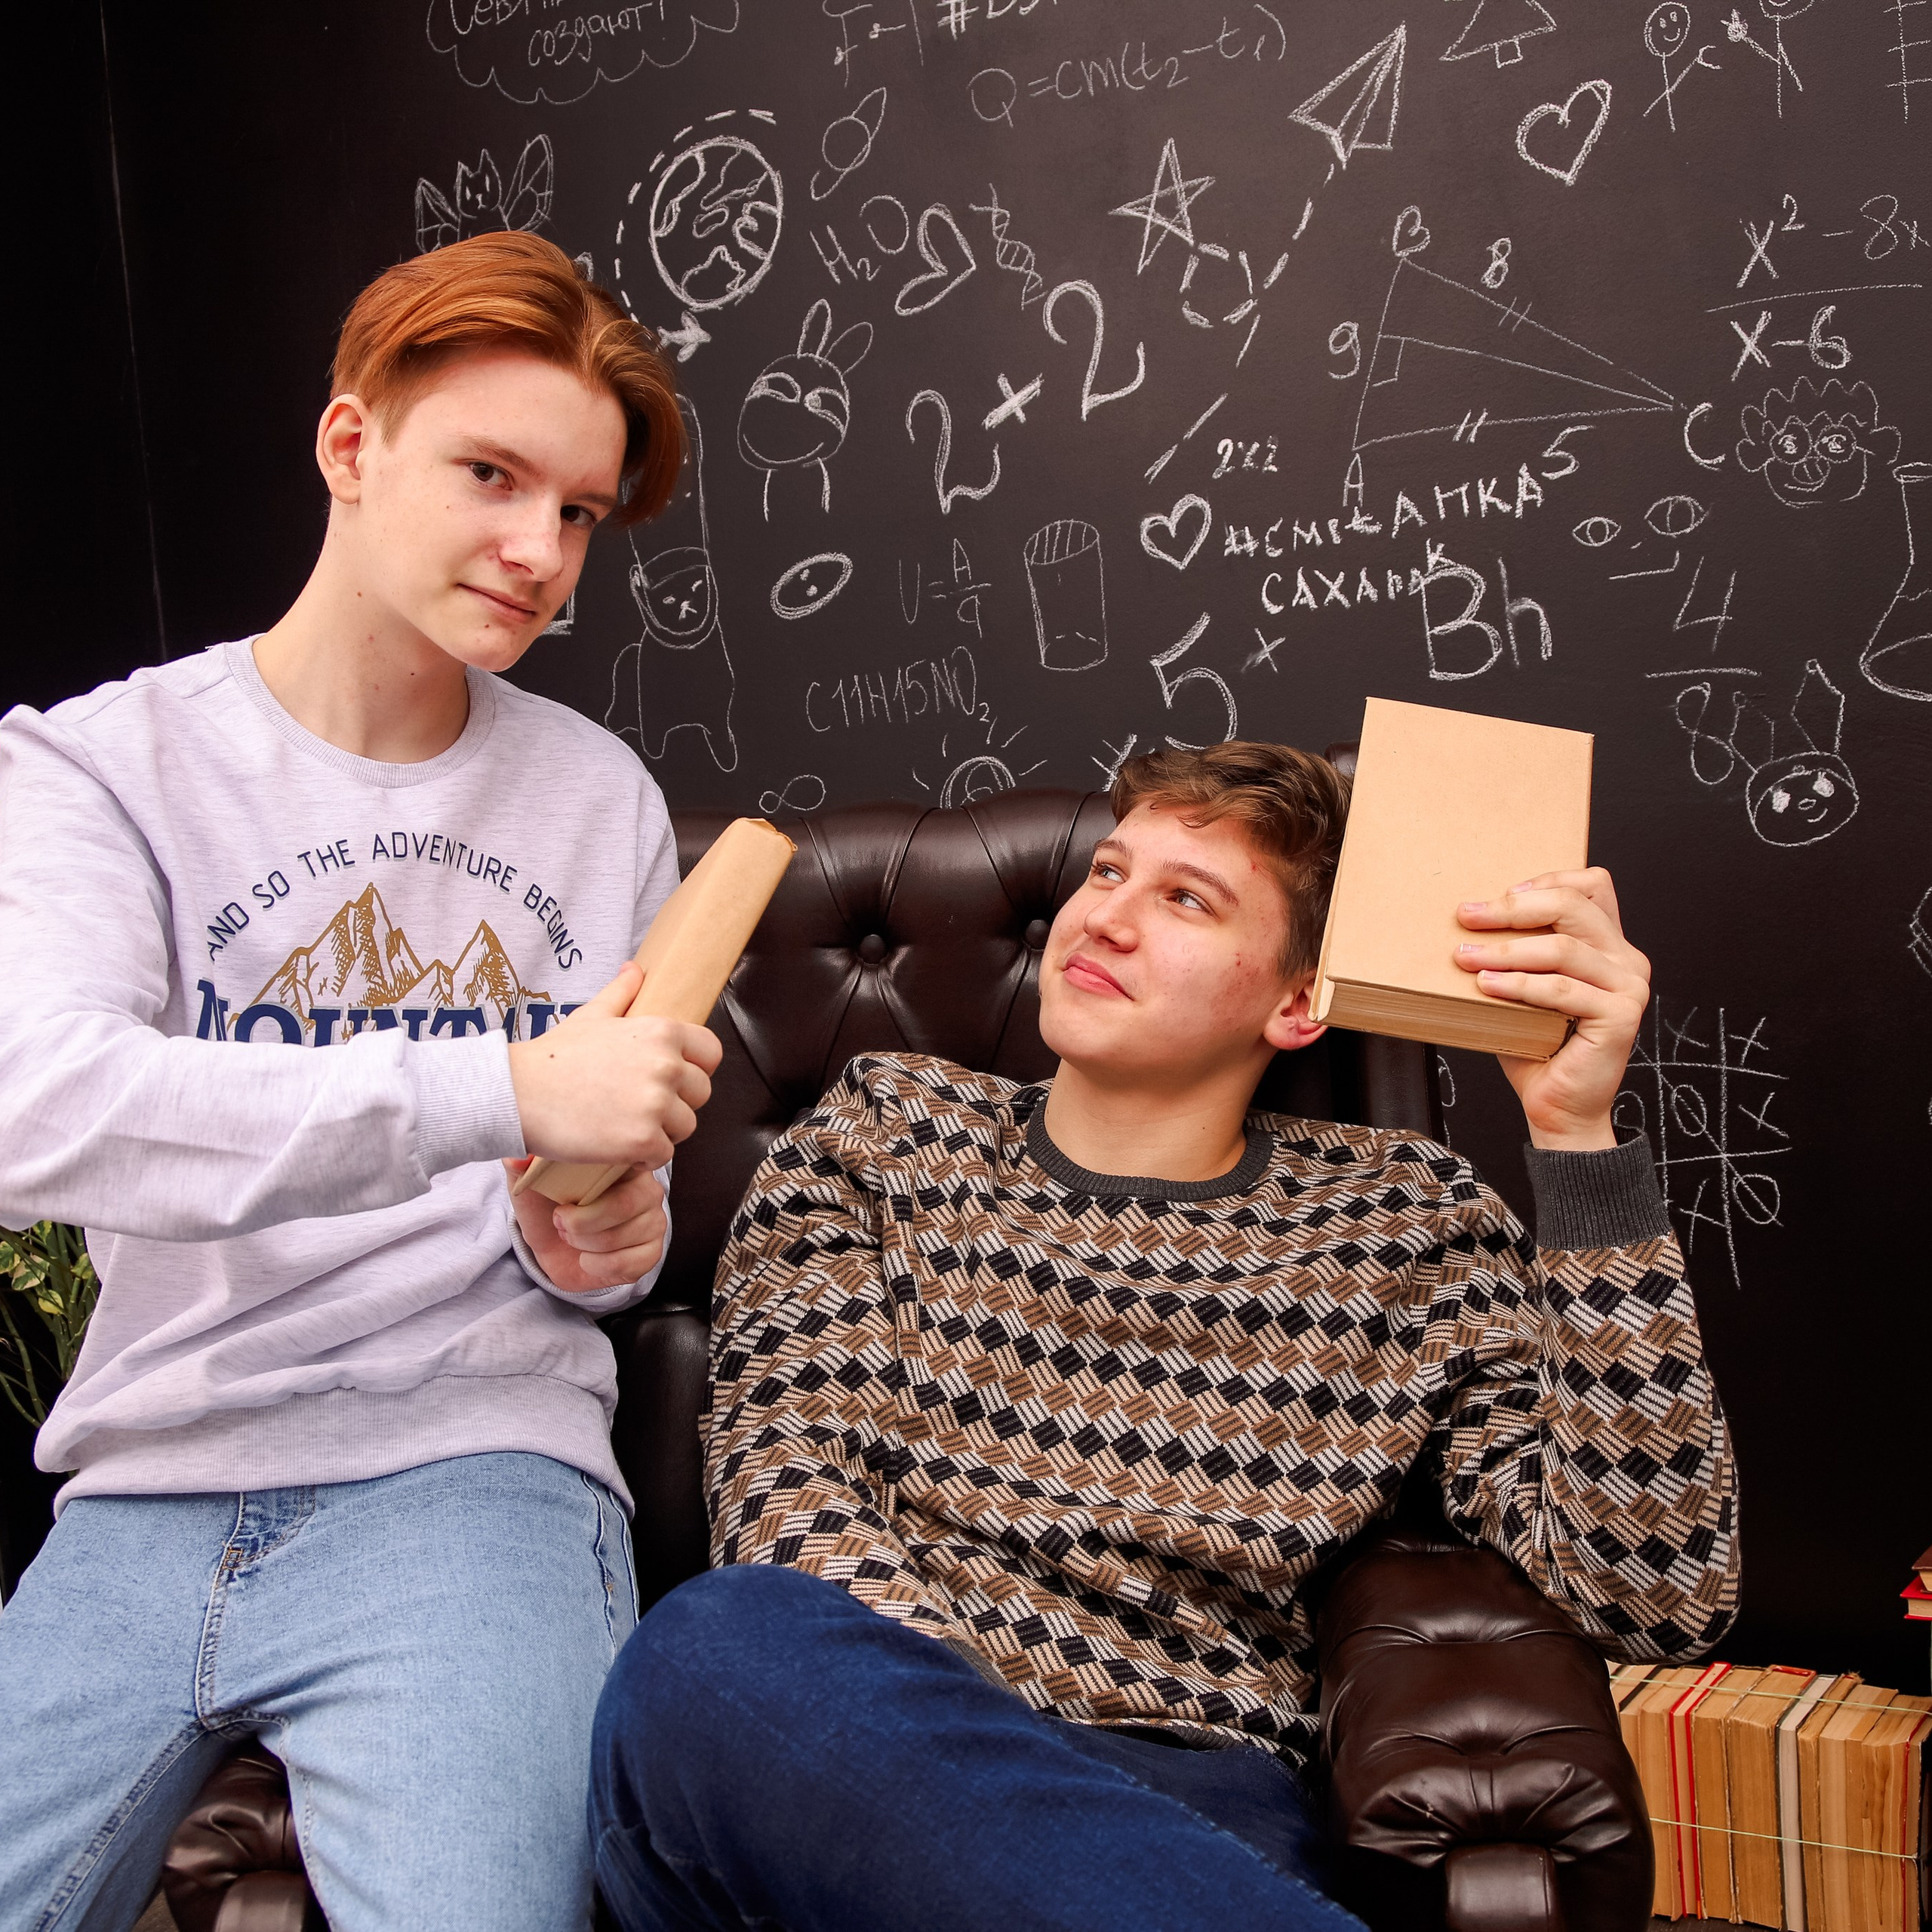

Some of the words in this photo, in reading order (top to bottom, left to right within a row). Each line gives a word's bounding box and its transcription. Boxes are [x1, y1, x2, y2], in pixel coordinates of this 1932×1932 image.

[1480, 236, 1512, 289] 8
[1328, 320, 1361, 380] 9
[1542, 425, 1596, 480] 5
[1672, 555, 1737, 654] 4
[206, 900, 251, 961] AND
[251, 869, 291, 909] SO
[297, 838, 356, 878] THE
[371, 831, 518, 893] ADVENTURE
[522, 882, 583, 970] BEGINS
